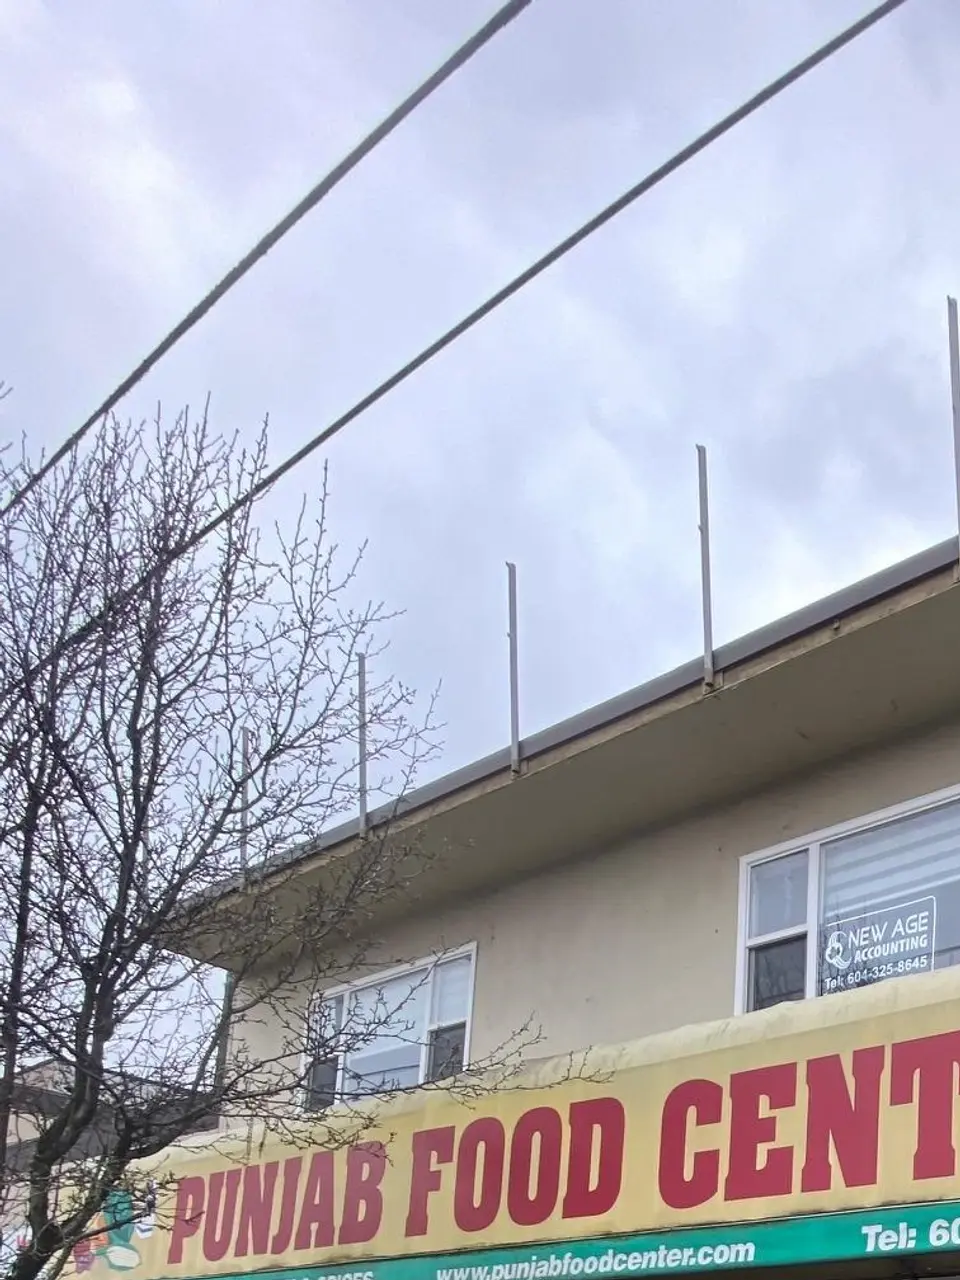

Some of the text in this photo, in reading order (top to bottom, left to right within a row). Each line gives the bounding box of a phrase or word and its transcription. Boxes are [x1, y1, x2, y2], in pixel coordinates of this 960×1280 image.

[848, 911, 929, 949] NEW AGE
[854, 934, 928, 964] ACCOUNTING
[848, 955, 928, 984] 604-325-8645
[167, 1141, 387, 1265] PUNJAB
[405, 1097, 625, 1238] FOOD
[861, 1221, 917, 1252] Tel:
